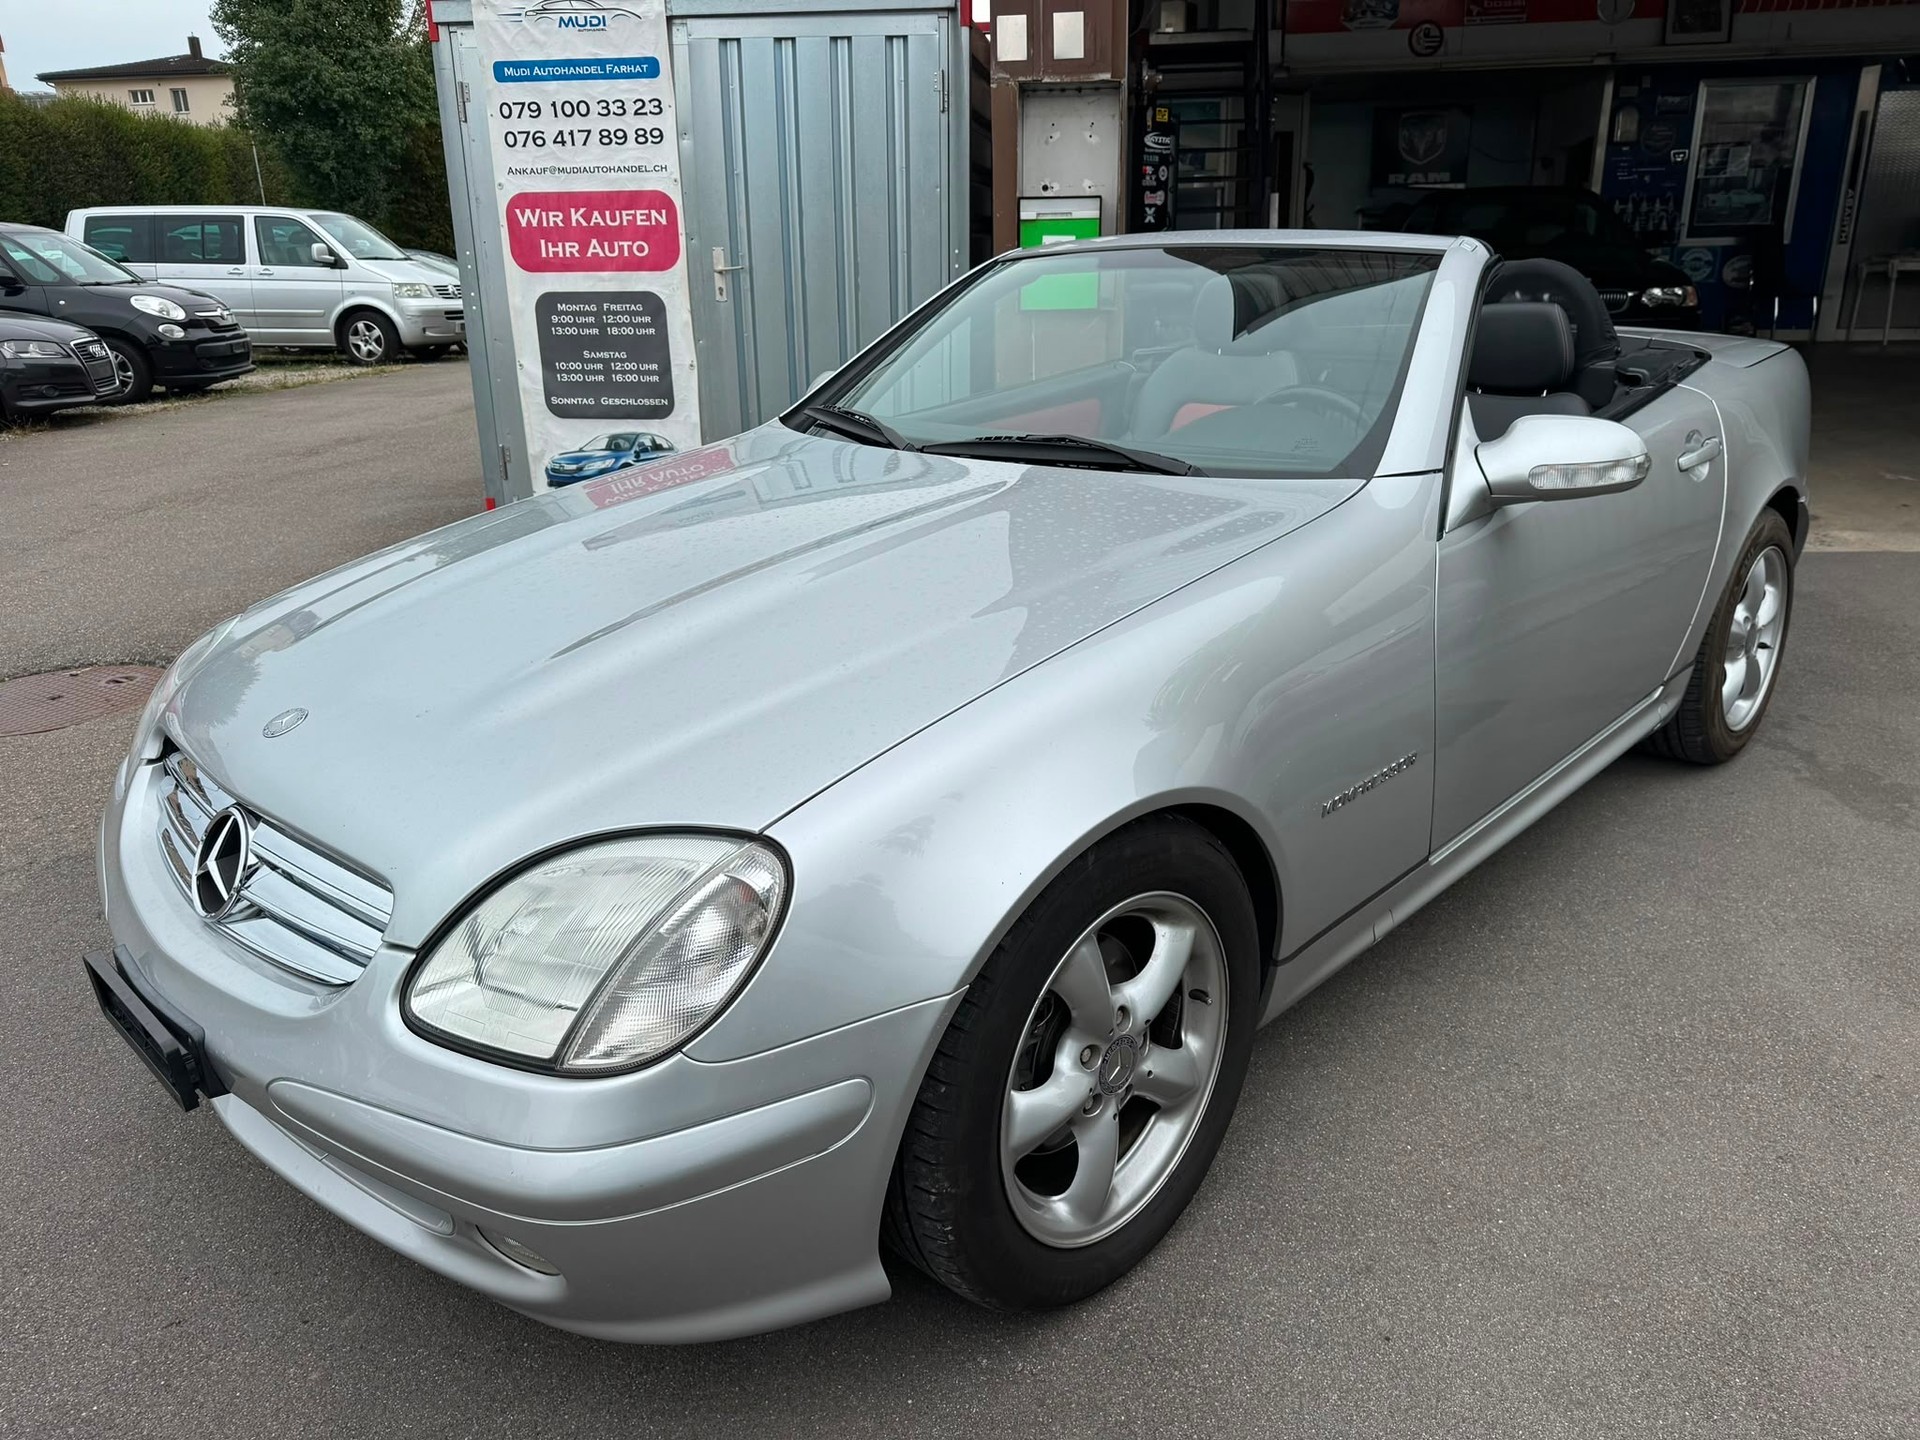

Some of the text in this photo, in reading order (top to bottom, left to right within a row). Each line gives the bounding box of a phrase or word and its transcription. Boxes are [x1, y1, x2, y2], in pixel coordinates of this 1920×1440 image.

[558, 15, 607, 28] MUDI
[504, 63, 649, 77] MUDI AUTOHANDEL FARHAT
[500, 98, 663, 119] 079 100 33 23
[504, 127, 664, 148] 076 417 89 89
[514, 207, 667, 228] WIR KAUFEN
[540, 238, 649, 258] IHR AUTO
[557, 303, 643, 311] MONTAG FREITAG
[551, 315, 574, 323] 9:00
[602, 315, 630, 323] 12:00
[551, 327, 578, 335] 13:00
[607, 327, 634, 335] 18:00
[583, 350, 627, 359] SAMSTAG
[555, 362, 582, 370] 10:00
[611, 362, 637, 371] 12:00
[639, 363, 658, 371] UHR
[556, 374, 583, 382] 13:00
[612, 374, 638, 382] 16:00
[551, 397, 668, 406] SONNTAG GESCHLOSSEN
